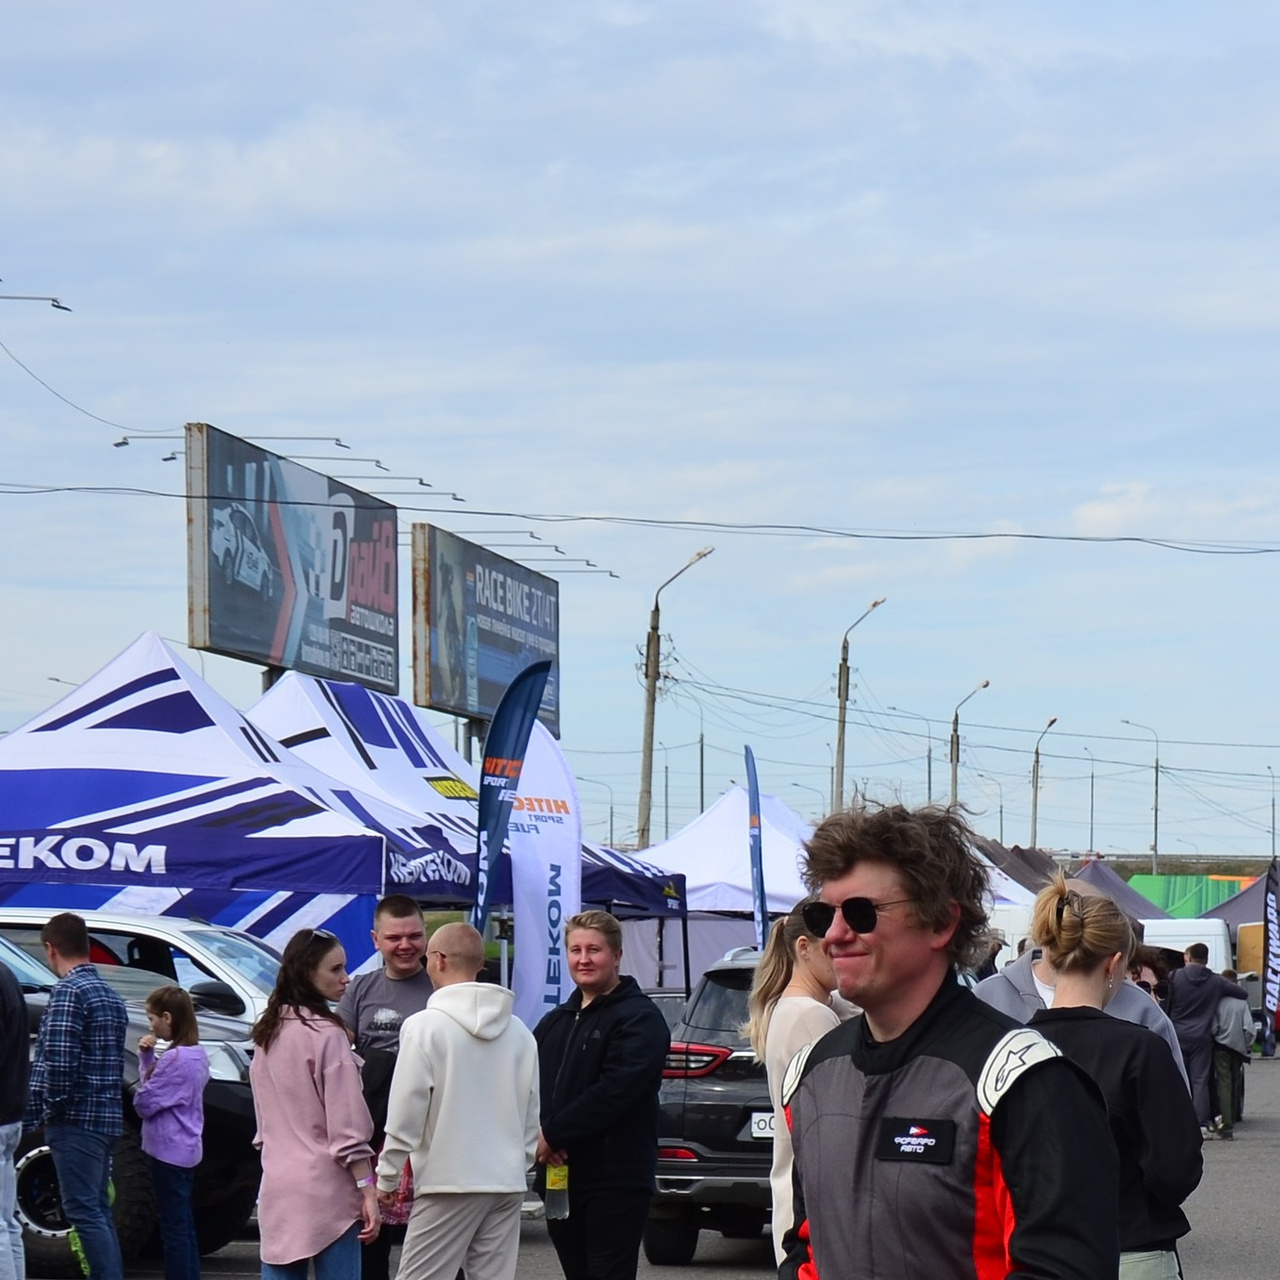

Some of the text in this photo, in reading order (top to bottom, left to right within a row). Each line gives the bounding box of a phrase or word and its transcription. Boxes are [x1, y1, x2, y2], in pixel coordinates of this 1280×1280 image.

[475, 564, 556, 632] RACE BIKE 2T/4T
